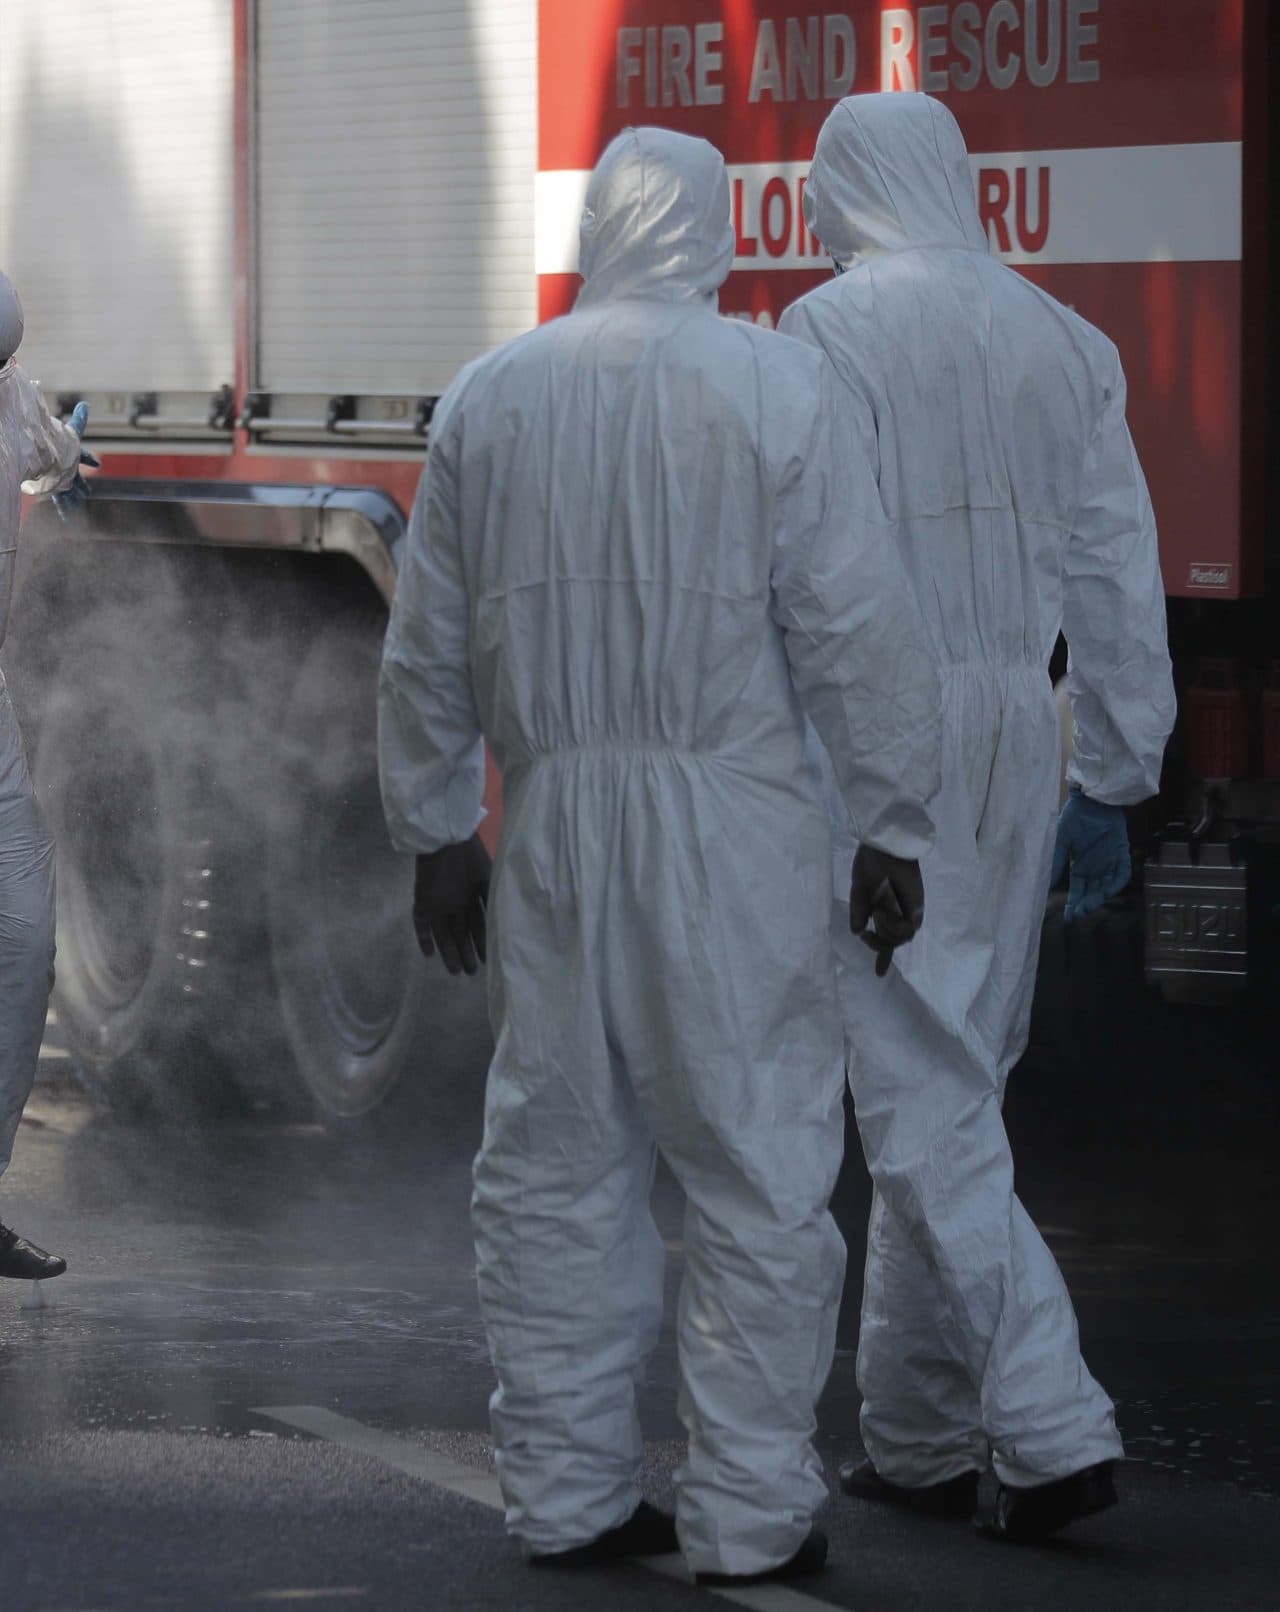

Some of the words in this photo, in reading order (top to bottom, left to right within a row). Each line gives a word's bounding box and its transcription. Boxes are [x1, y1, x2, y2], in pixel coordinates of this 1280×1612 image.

[616, 22, 724, 108] FIRE
[748, 14, 857, 103] AND
[880, 0, 1100, 93] RESCUE
